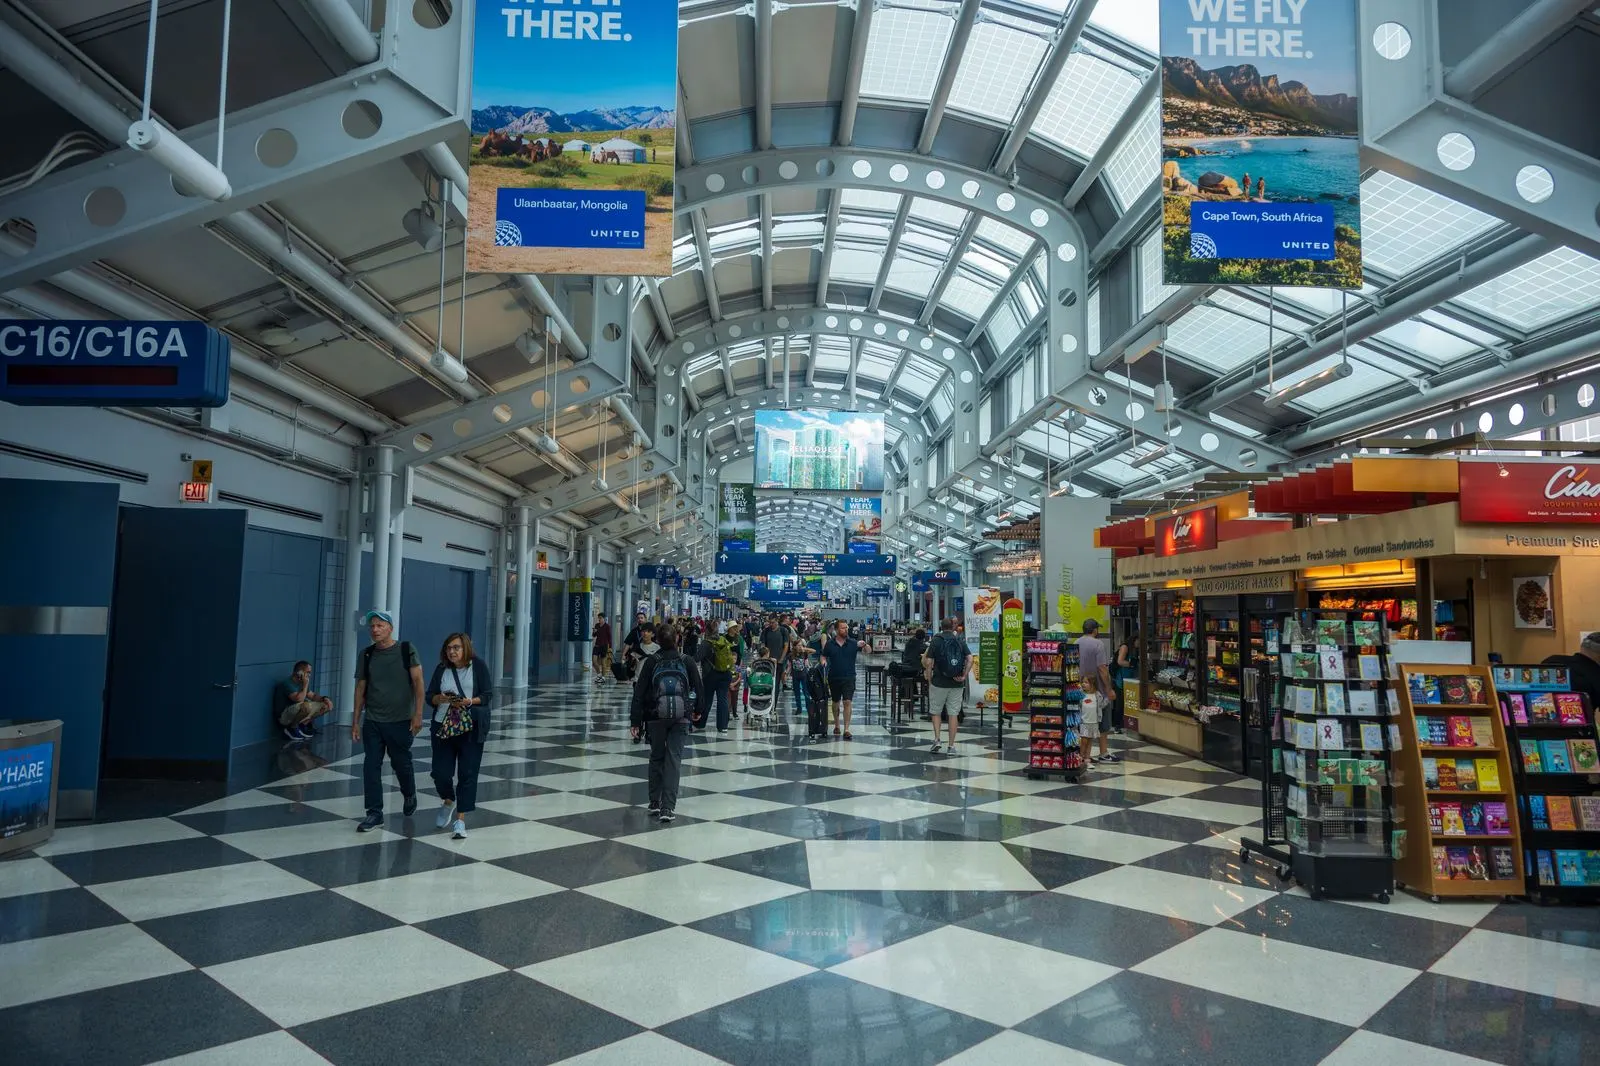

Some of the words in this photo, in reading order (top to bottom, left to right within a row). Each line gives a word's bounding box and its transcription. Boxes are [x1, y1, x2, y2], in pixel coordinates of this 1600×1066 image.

[1187, 0, 1246, 23] WE
[1254, 0, 1308, 25] FLY
[501, 8, 632, 42] THERE.
[1187, 27, 1314, 60] THERE.
[514, 198, 579, 211] Ulaanbaatar,
[580, 199, 628, 212] Mongolia
[1202, 211, 1229, 222] Cape
[1231, 211, 1260, 223] Town,
[1261, 212, 1291, 222] South
[1293, 212, 1323, 223] Africa
[590, 229, 640, 238] UNITED
[1282, 241, 1330, 250] UNITED
[1, 325, 188, 360] C16/C16A
[1544, 465, 1600, 499] Ciao
[185, 483, 207, 498] EXIT
[1506, 534, 1567, 548] Premium
[1258, 556, 1280, 566] Premium
[1281, 553, 1301, 564] Snacks
[1306, 550, 1324, 561] Fresh
[1325, 547, 1347, 559] Salads
[1353, 543, 1384, 556] Gourmet
[1386, 538, 1434, 553] Sandwiches
[1197, 582, 1213, 593] CIAO
[1214, 577, 1248, 592] GOURMET
[1251, 575, 1284, 589] MARKET
[966, 616, 993, 625] WICKER
[1005, 620, 1021, 629] well
[1125, 688, 1137, 699] PAY
[1124, 699, 1139, 711] HERE
